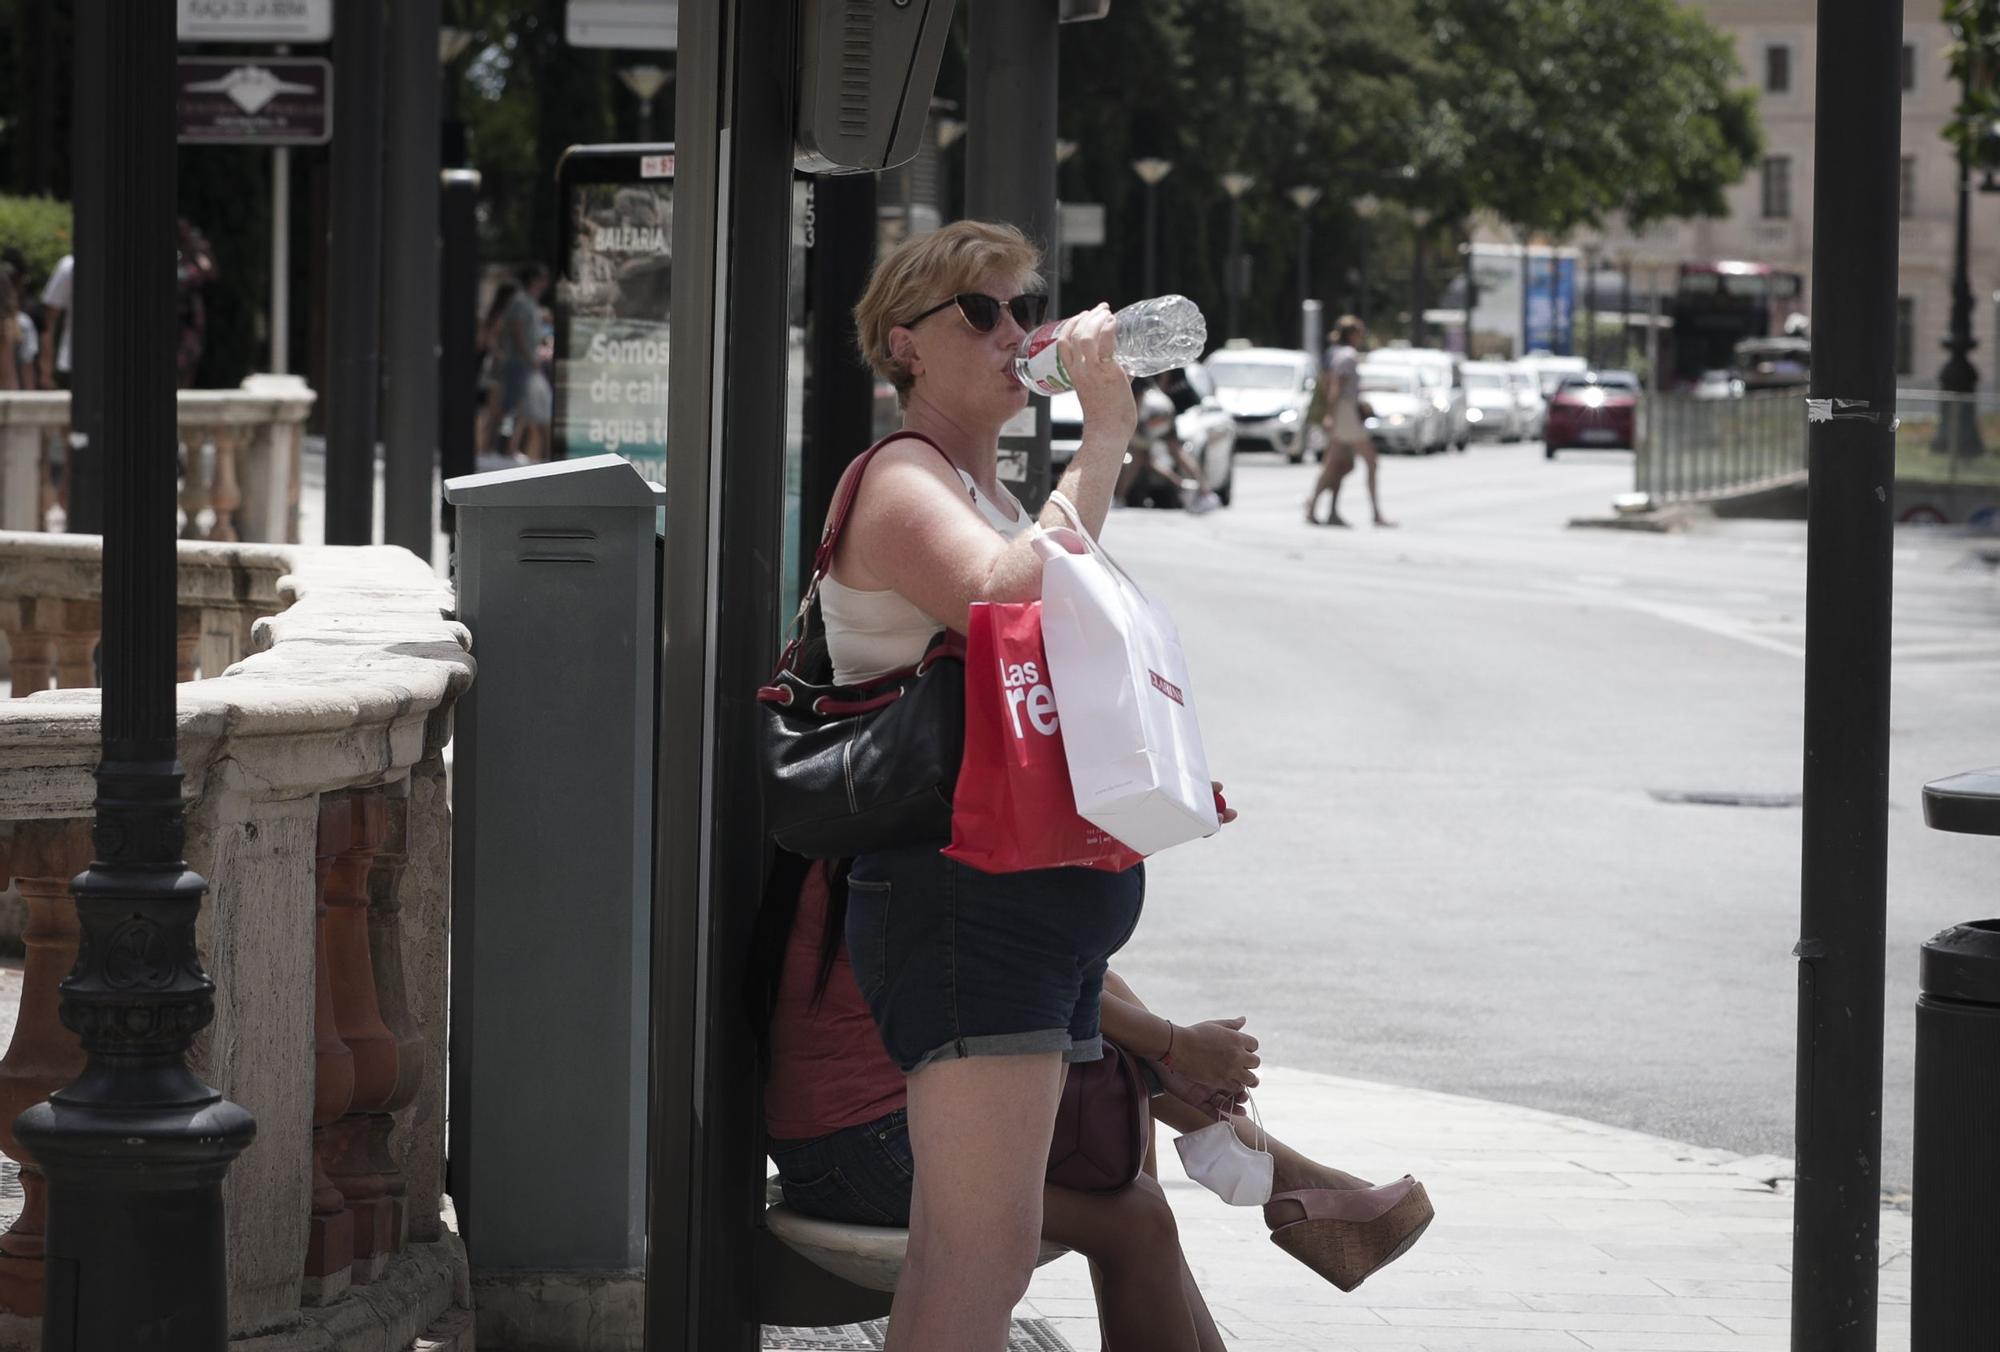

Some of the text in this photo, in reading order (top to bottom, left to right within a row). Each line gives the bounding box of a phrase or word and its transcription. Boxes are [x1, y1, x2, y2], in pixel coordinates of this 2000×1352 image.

[591, 333, 670, 364] Somos
[591, 373, 620, 403] de
[589, 418, 647, 451] agua
[1000, 658, 1039, 687] Las
[1005, 684, 1058, 739] re
